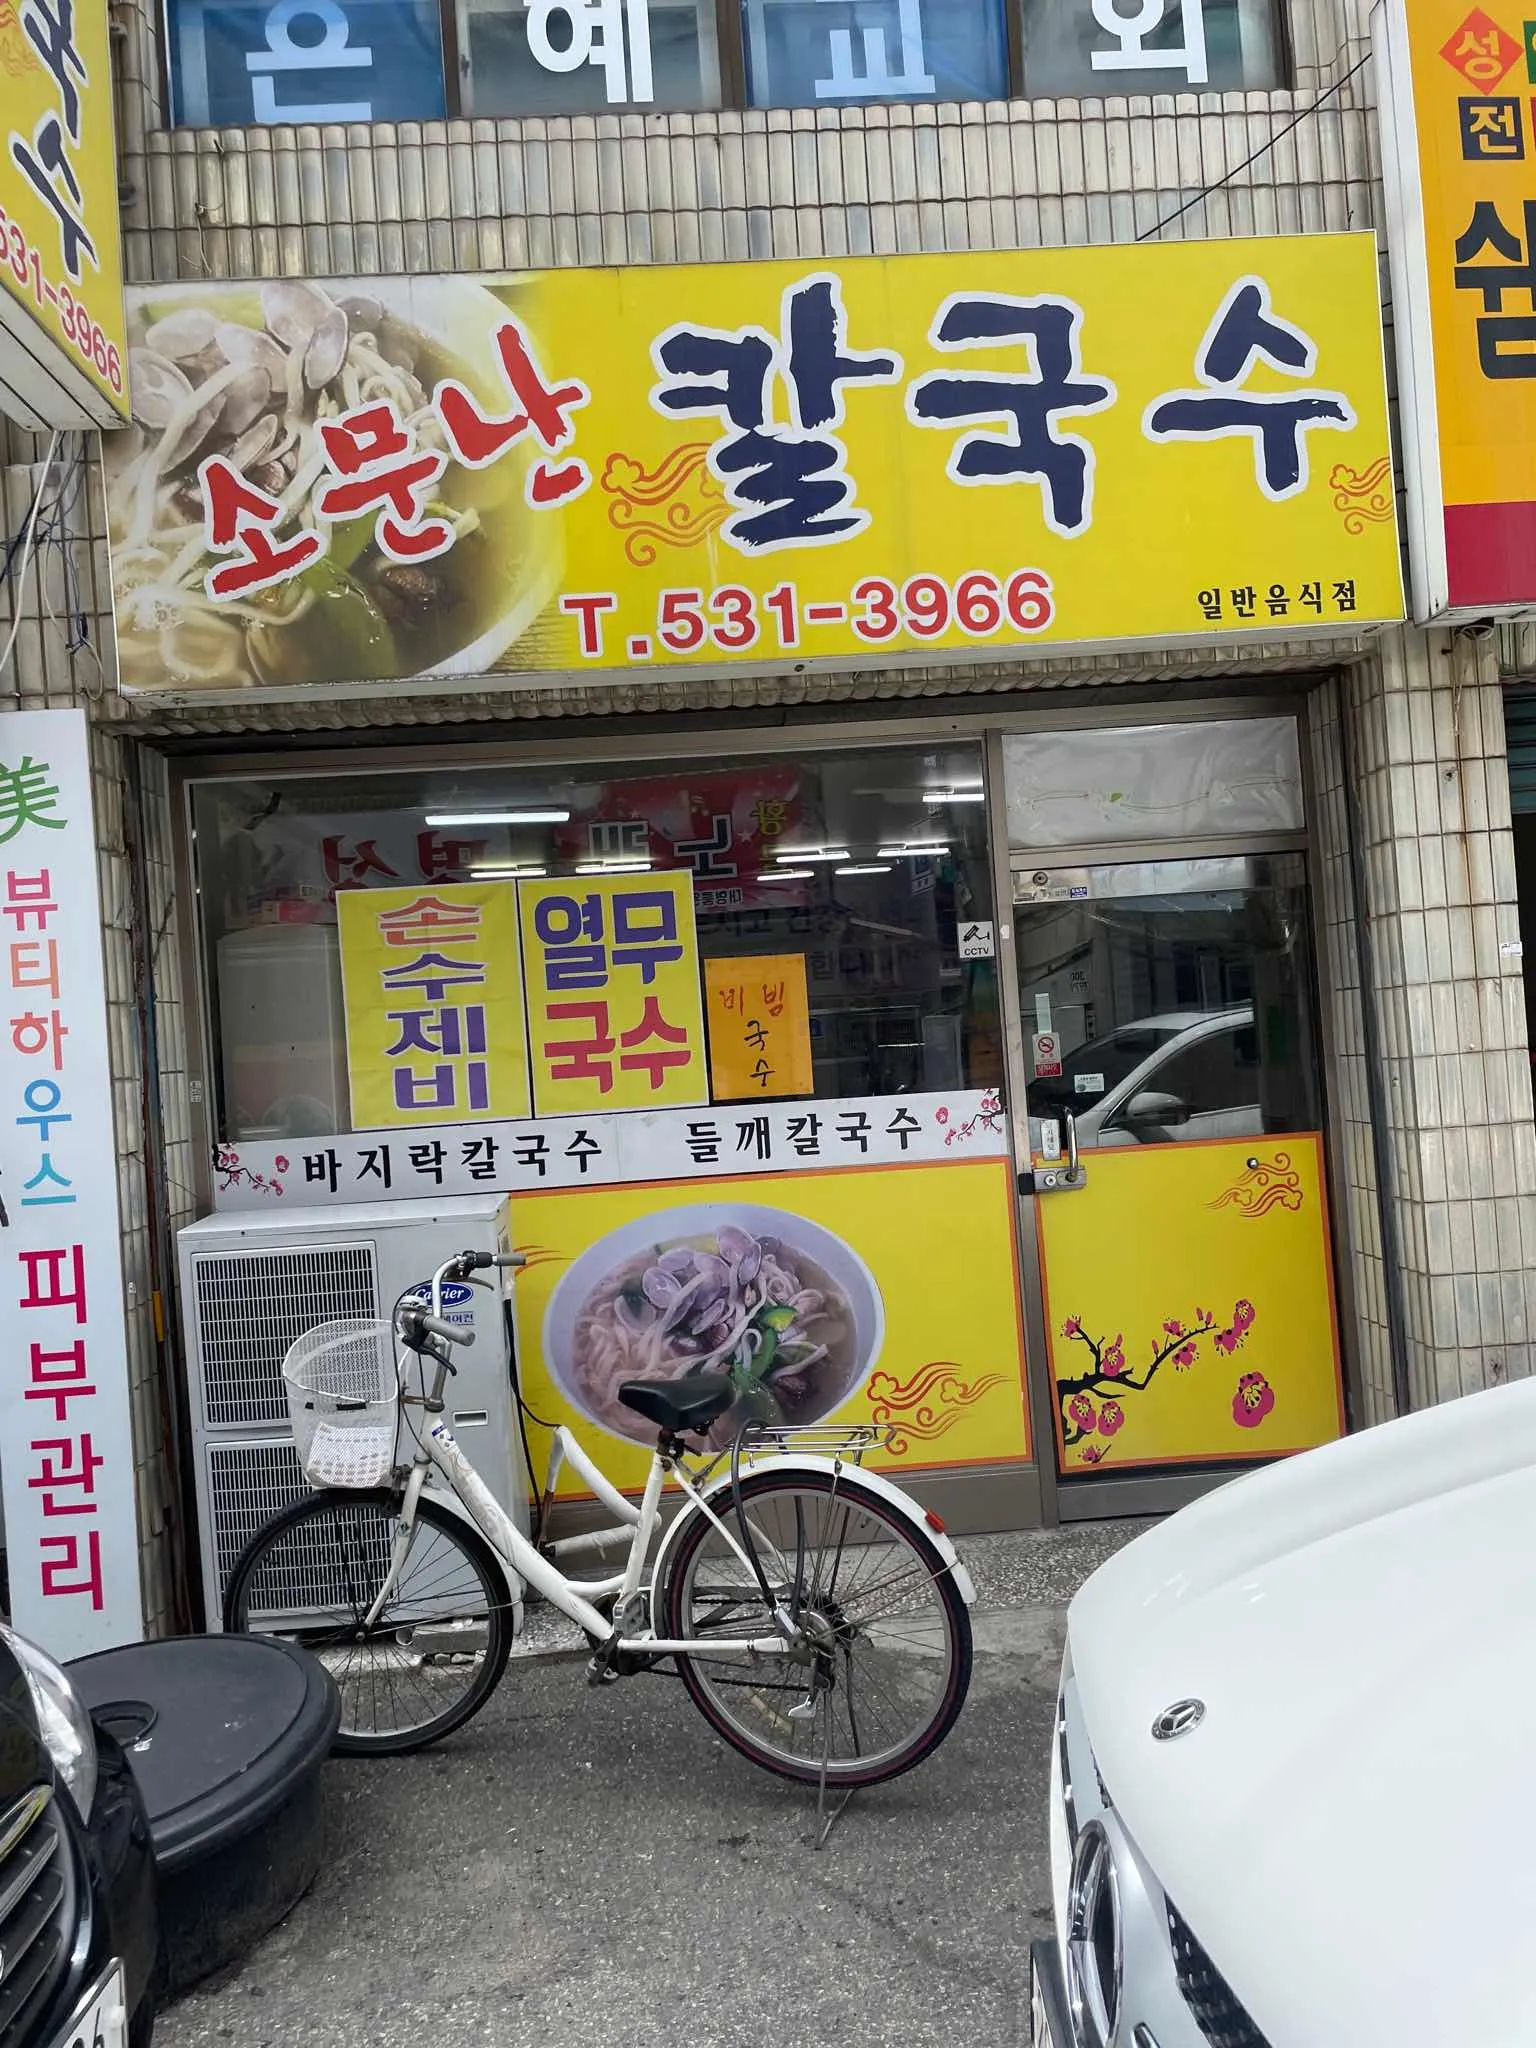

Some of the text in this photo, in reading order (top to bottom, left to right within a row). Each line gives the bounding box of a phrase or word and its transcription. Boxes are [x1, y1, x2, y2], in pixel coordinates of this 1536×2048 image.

[206, 281, 1348, 594] 소문난 칼국수
[1198, 580, 1357, 620] 일반음식점
[0, 756, 68, 844] 美
[534, 890, 684, 990] 열무
[964, 946, 990, 957] CCTV
[380, 896, 489, 1111] 손수제비
[542, 996, 692, 1094] 국수
[744, 1020, 776, 1088] 국수
[302, 1130, 602, 1193] 바지락칼국수
[685, 1107, 923, 1163] 들깨칼국수
[3, 868, 104, 1611] 뷰티하우스 피부관리
[415, 1287, 465, 1300] Carier
